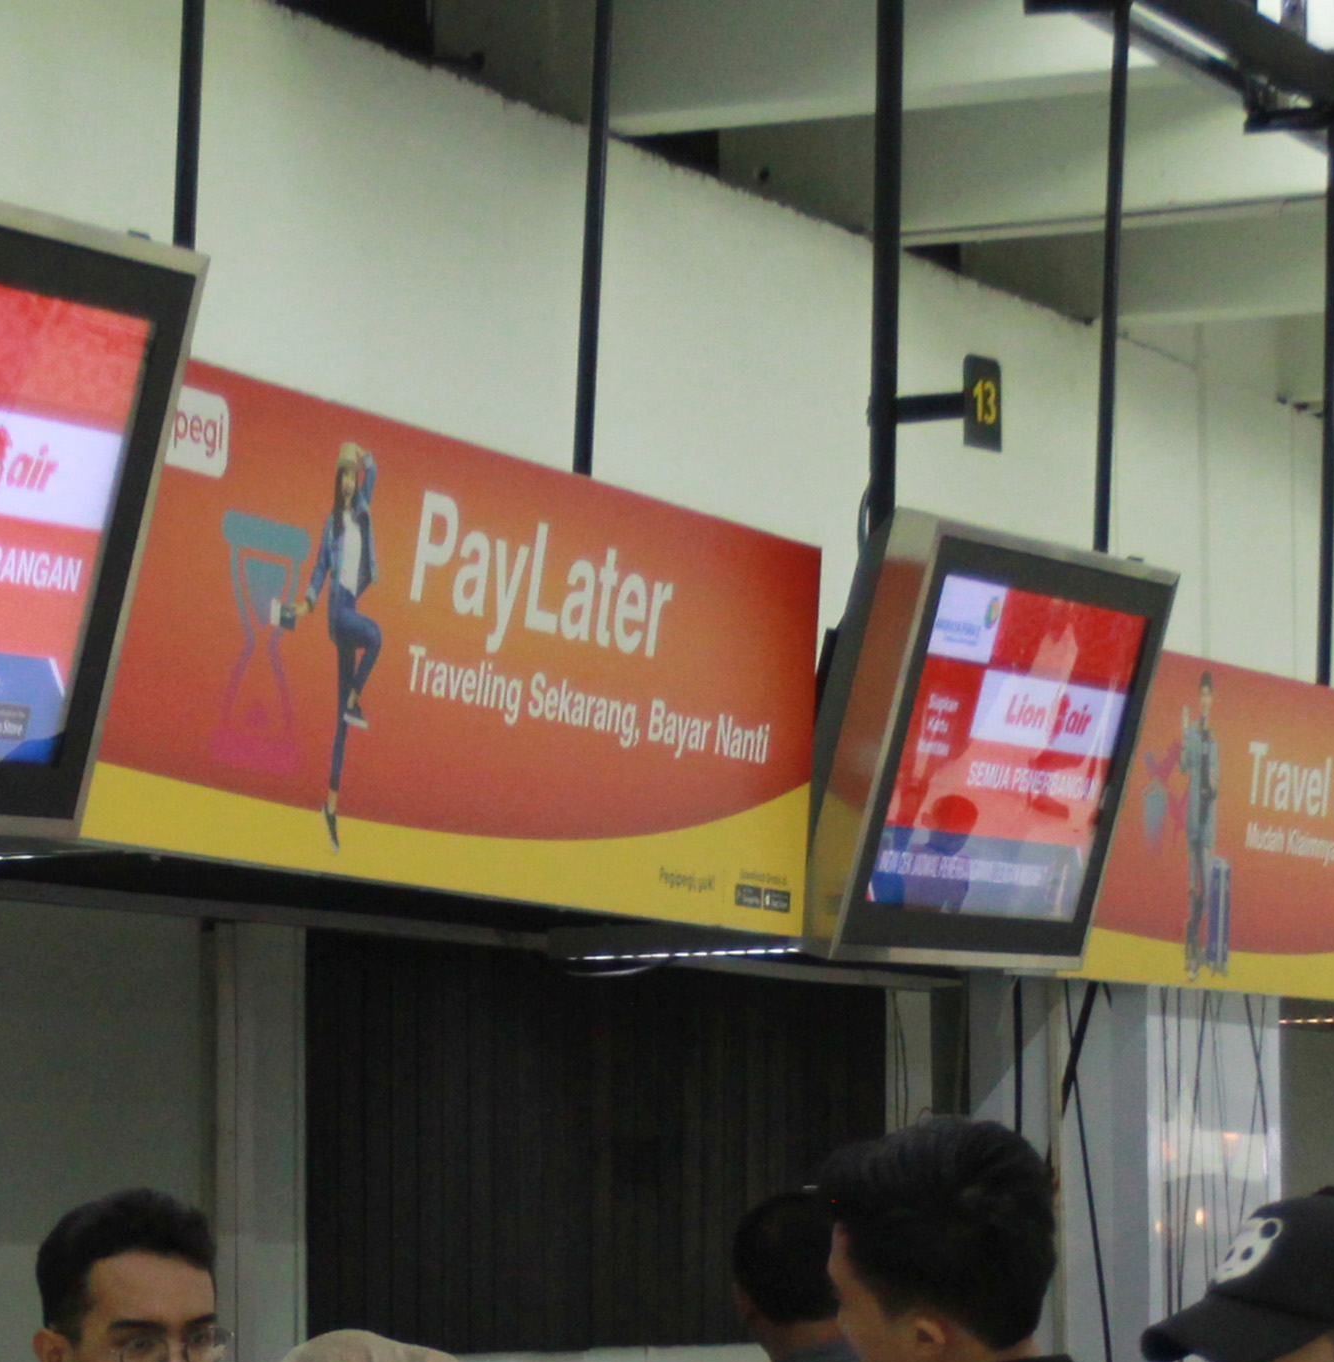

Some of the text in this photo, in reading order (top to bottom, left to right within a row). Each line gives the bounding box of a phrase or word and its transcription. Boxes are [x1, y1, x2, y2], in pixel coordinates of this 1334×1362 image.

[972, 378, 997, 426] 13
[173, 408, 225, 457] pegi
[5, 445, 59, 494] air
[409, 489, 674, 658] PayLater
[407, 645, 771, 765] Traveling Sekarang, Bayar Nanti
[1005, 692, 1093, 736] Lion air
[966, 760, 1099, 800] SEMUA PENERBANGAN
[1249, 740, 1333, 818] Travel
